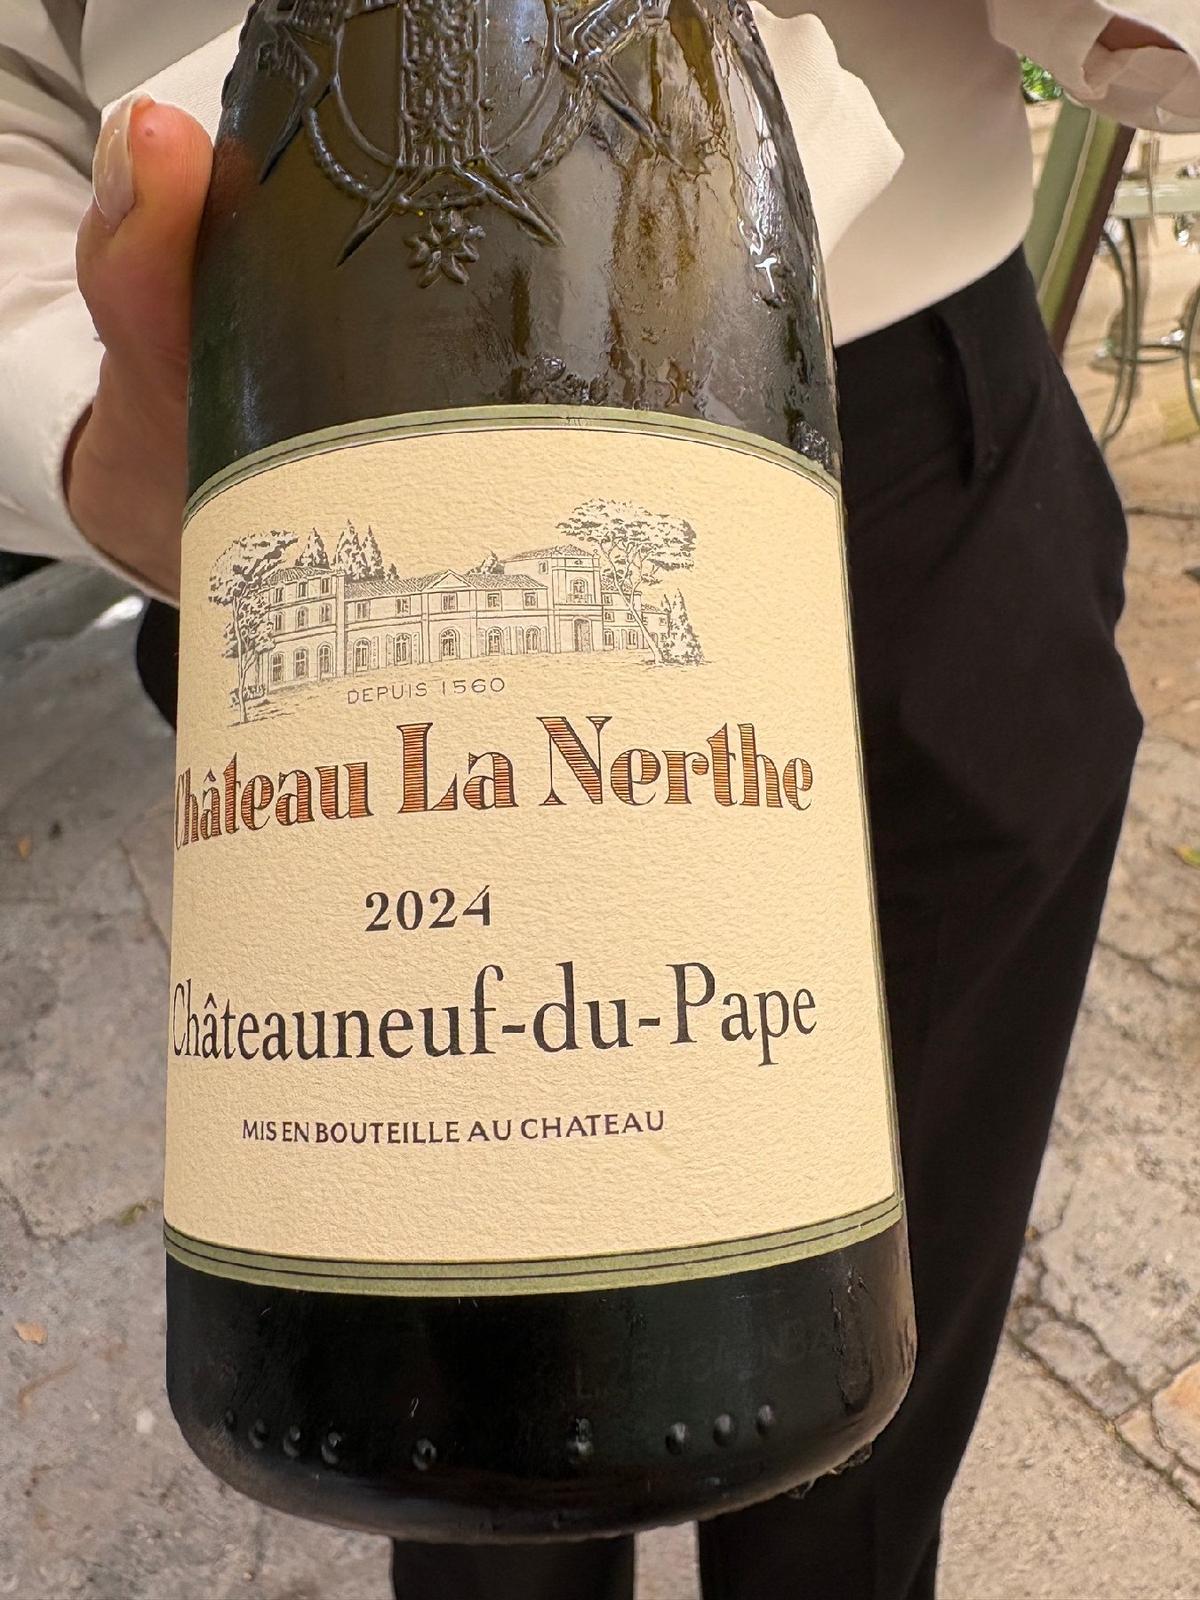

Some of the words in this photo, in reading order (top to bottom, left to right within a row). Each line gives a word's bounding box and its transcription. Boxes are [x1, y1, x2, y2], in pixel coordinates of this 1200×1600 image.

[347, 682, 428, 705] DEPUIS
[442, 677, 506, 696] 1560
[175, 752, 375, 851] Château
[396, 721, 520, 814] La
[536, 715, 814, 811] Nerthe
[365, 884, 492, 932] 2024
[172, 960, 818, 1067] Châteauneuf-du-Pape
[242, 1119, 277, 1142] MIS
[282, 1121, 310, 1143] EN
[315, 1120, 461, 1145] BOUTEILLE
[468, 1119, 513, 1141] AU
[520, 1110, 665, 1140] CHATEAU
